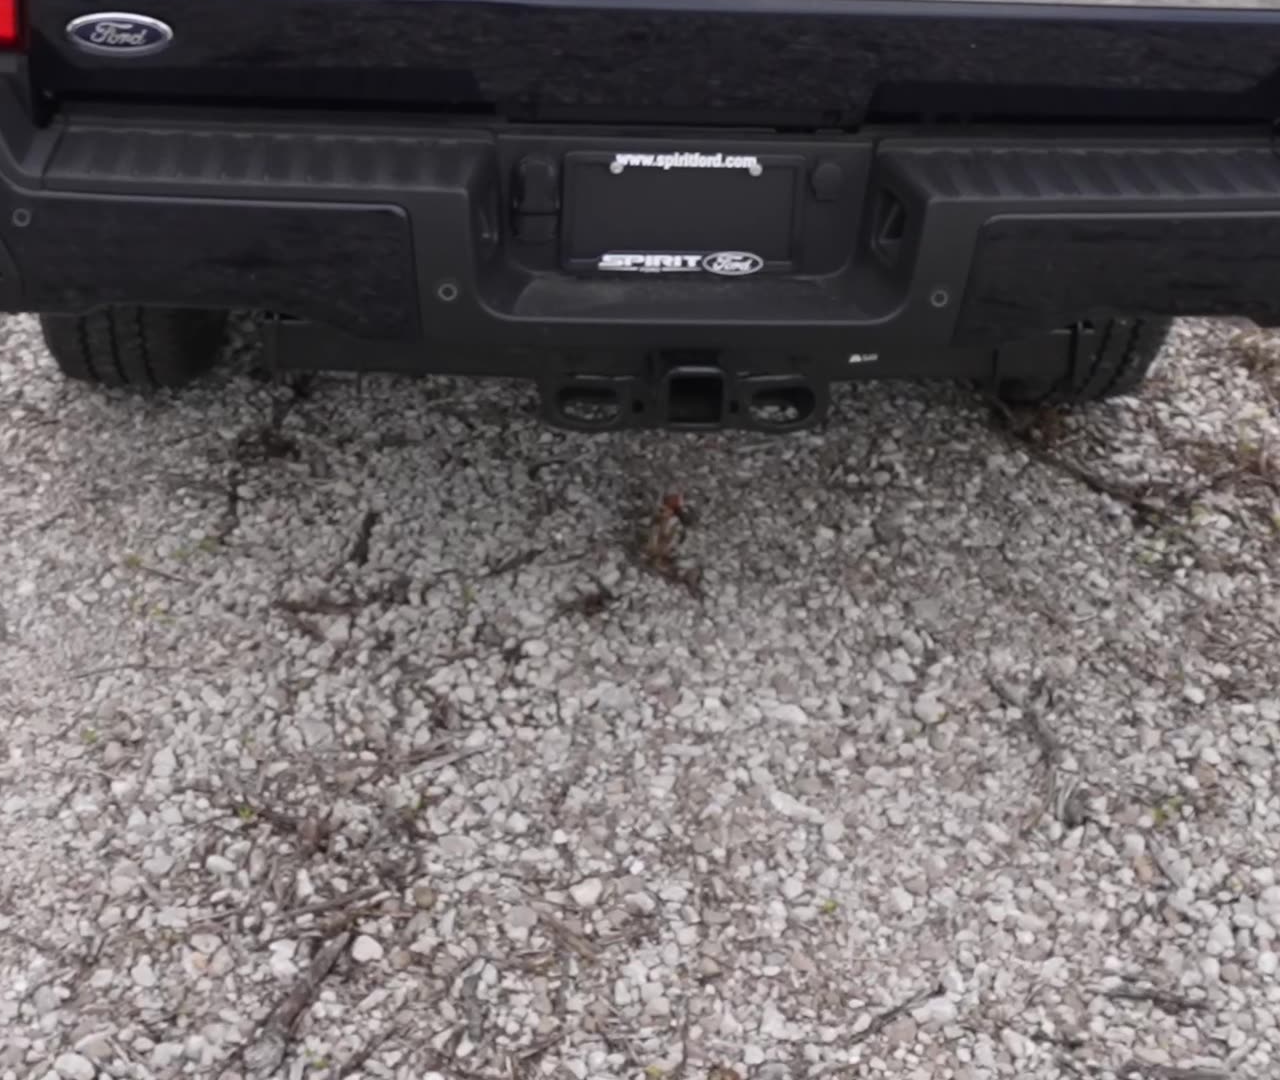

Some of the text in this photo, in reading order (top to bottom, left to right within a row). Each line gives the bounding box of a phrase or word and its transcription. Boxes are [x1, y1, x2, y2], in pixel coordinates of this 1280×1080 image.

[89, 21, 148, 45] Ford
[614, 151, 758, 170] www.spiritford.com
[598, 253, 703, 268] SPIRIT
